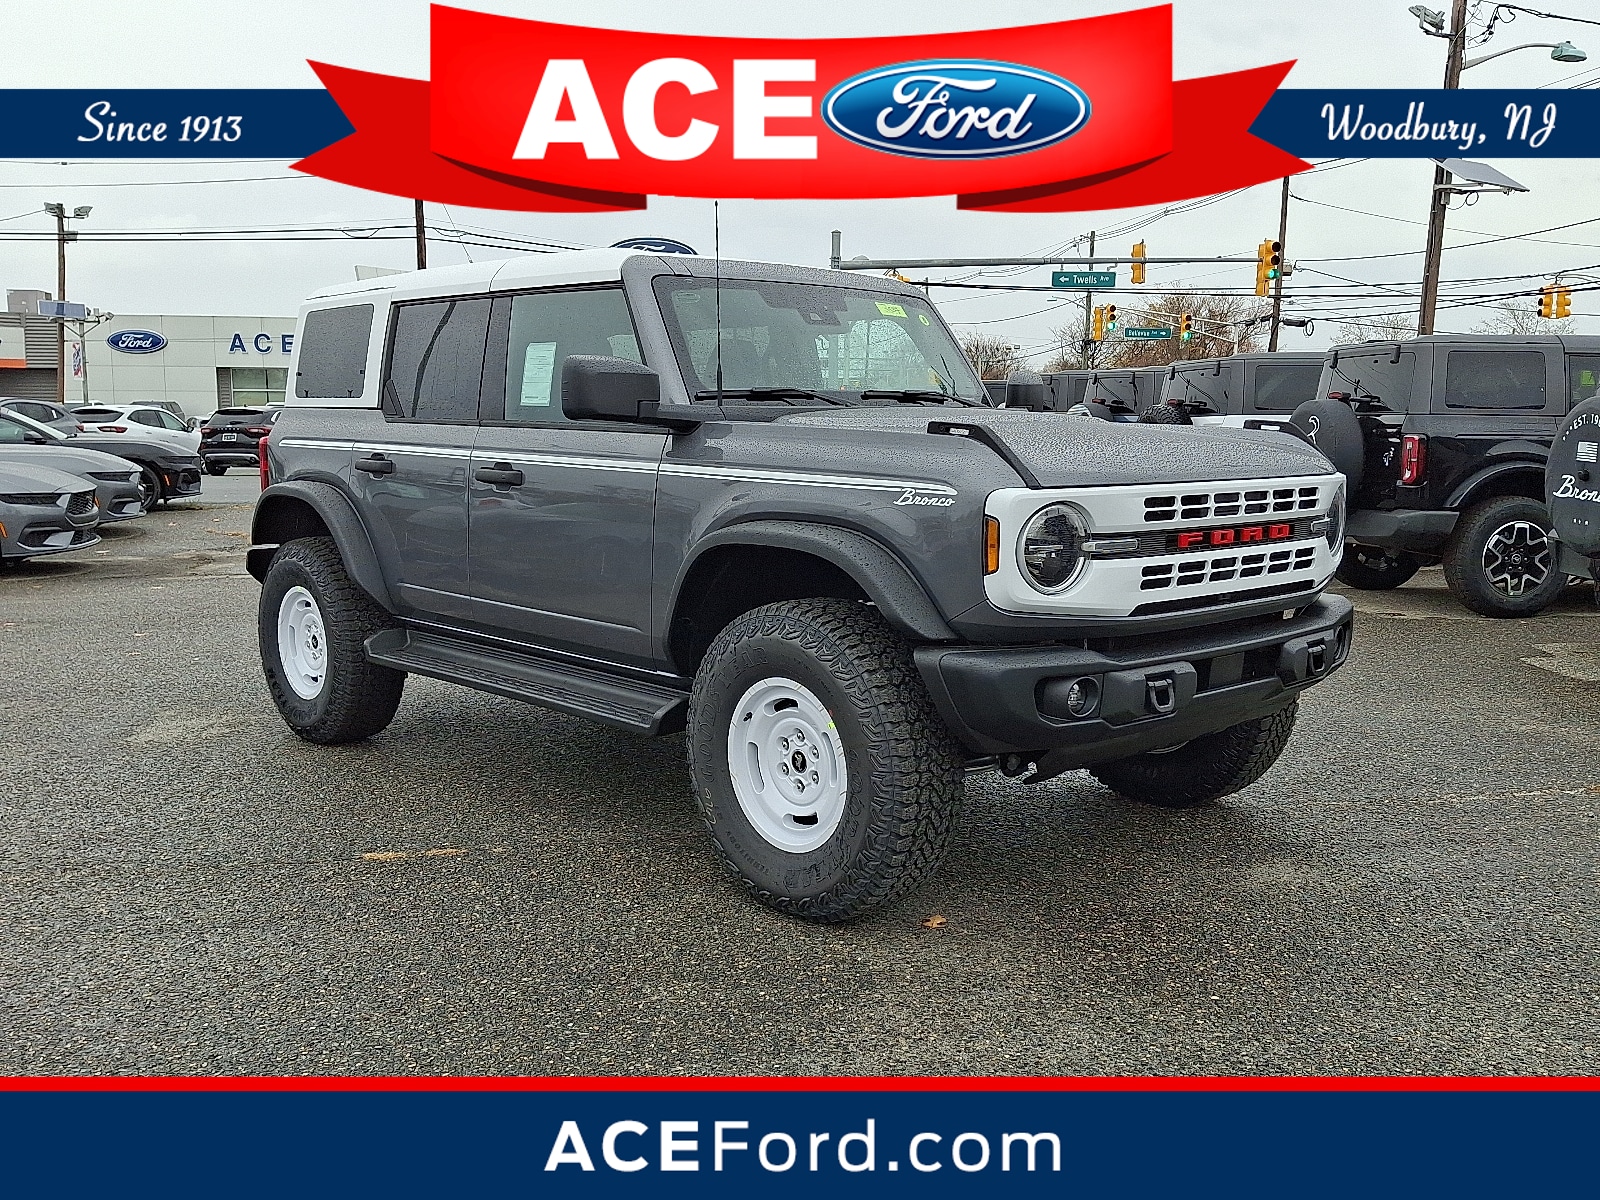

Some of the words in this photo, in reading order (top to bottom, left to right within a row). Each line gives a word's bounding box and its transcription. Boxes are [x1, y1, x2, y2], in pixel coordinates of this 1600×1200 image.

[1073, 275, 1097, 284] Twells
[118, 333, 153, 348] Ford
[229, 333, 294, 354] ACE
[1573, 414, 1589, 430] EST.
[892, 488, 956, 507] Bronco
[1178, 524, 1289, 548] FORD
